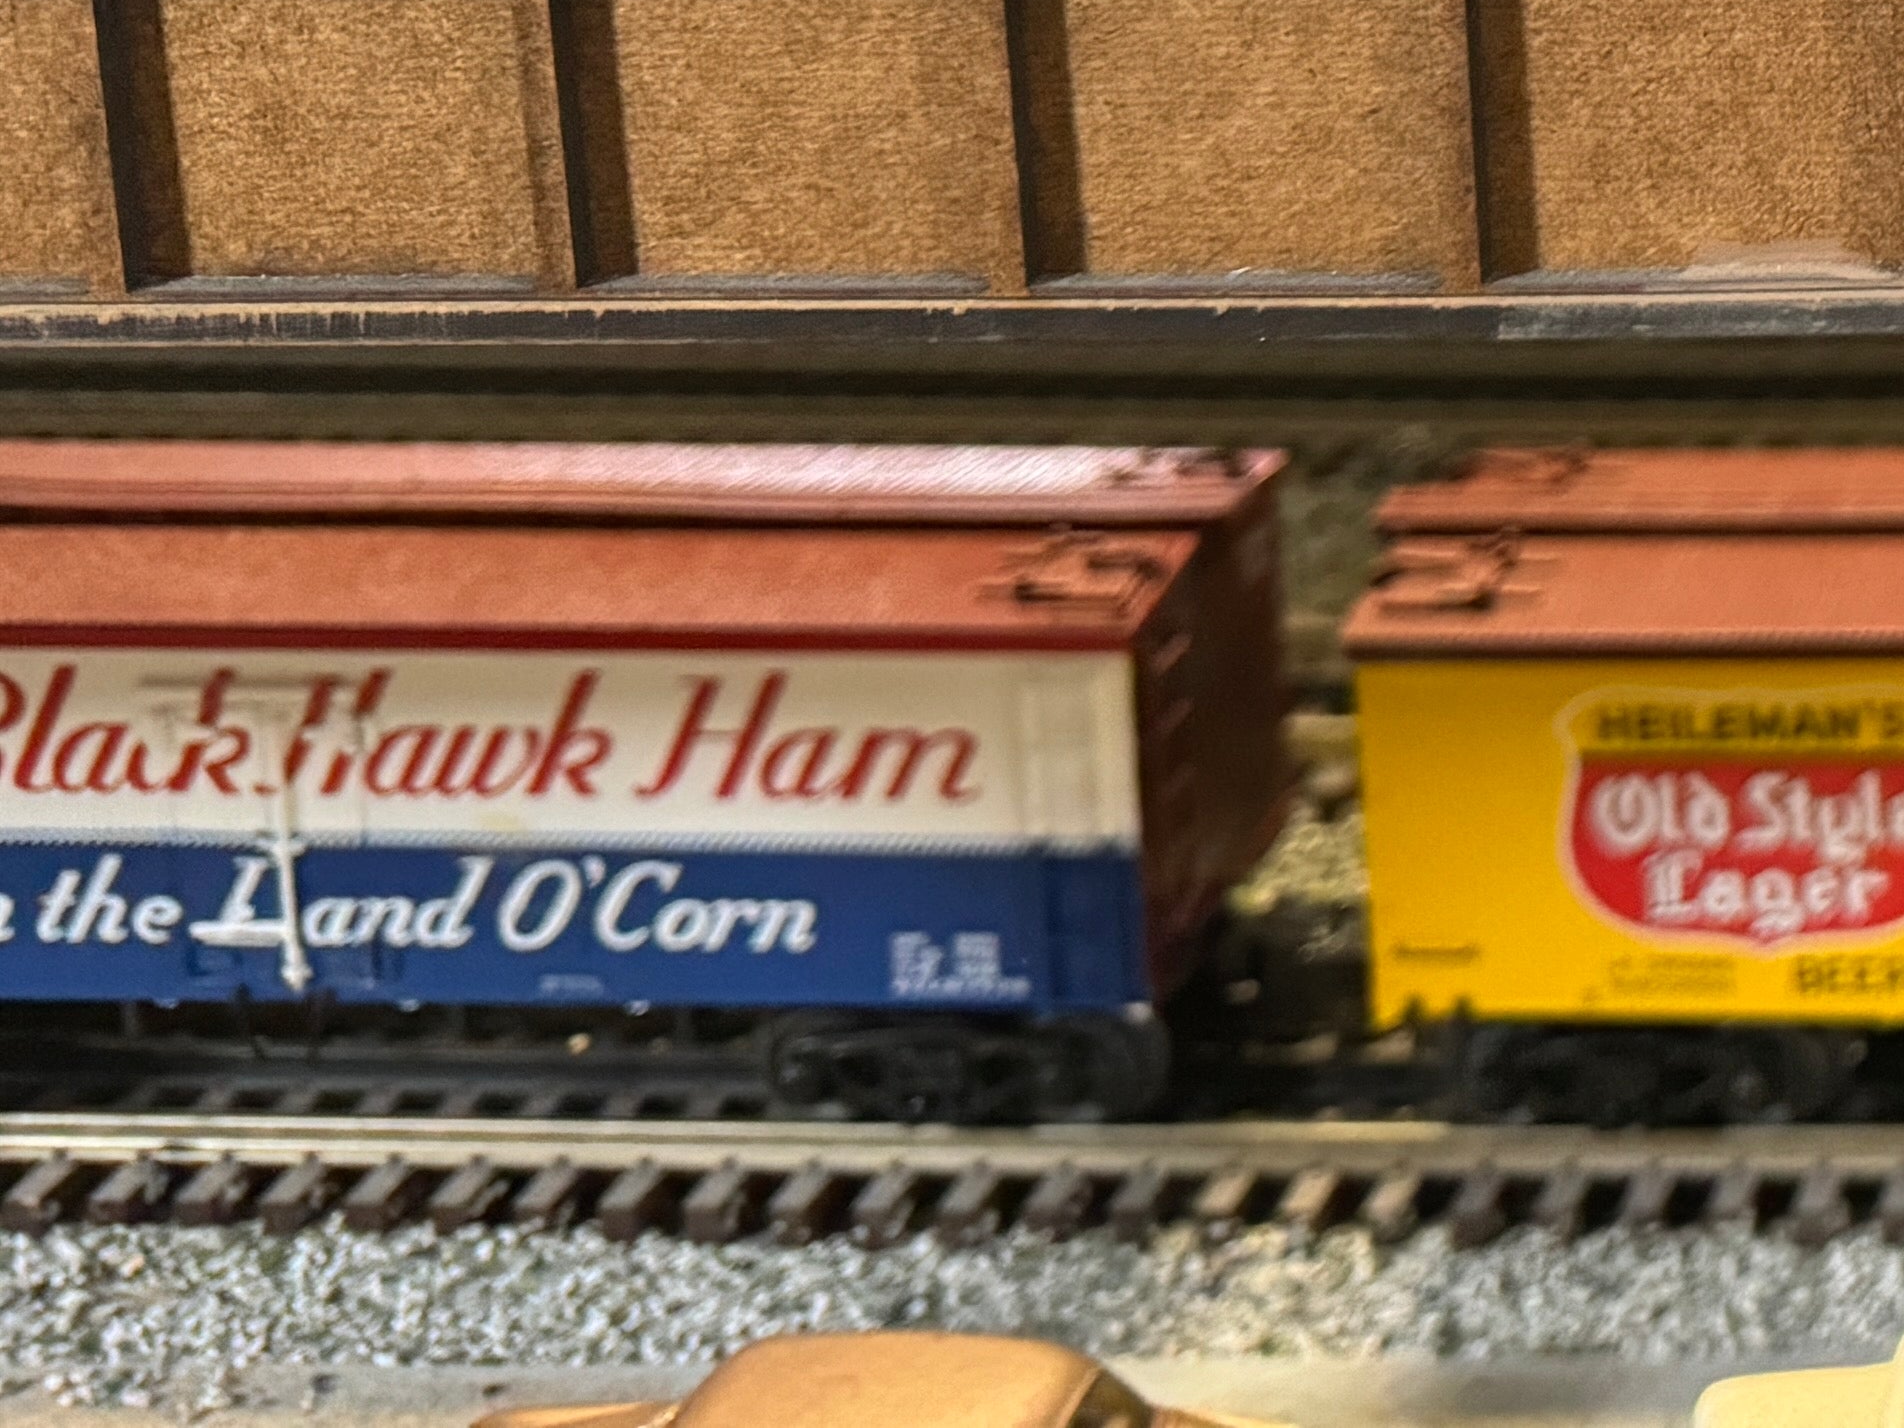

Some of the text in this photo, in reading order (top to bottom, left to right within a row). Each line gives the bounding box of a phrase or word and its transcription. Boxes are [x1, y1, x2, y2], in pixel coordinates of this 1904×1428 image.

[640, 671, 984, 804] Ham
[1591, 770, 1732, 855] Old
[36, 853, 183, 944] the
[189, 855, 494, 948] Land
[1641, 847, 1891, 934] Lager
